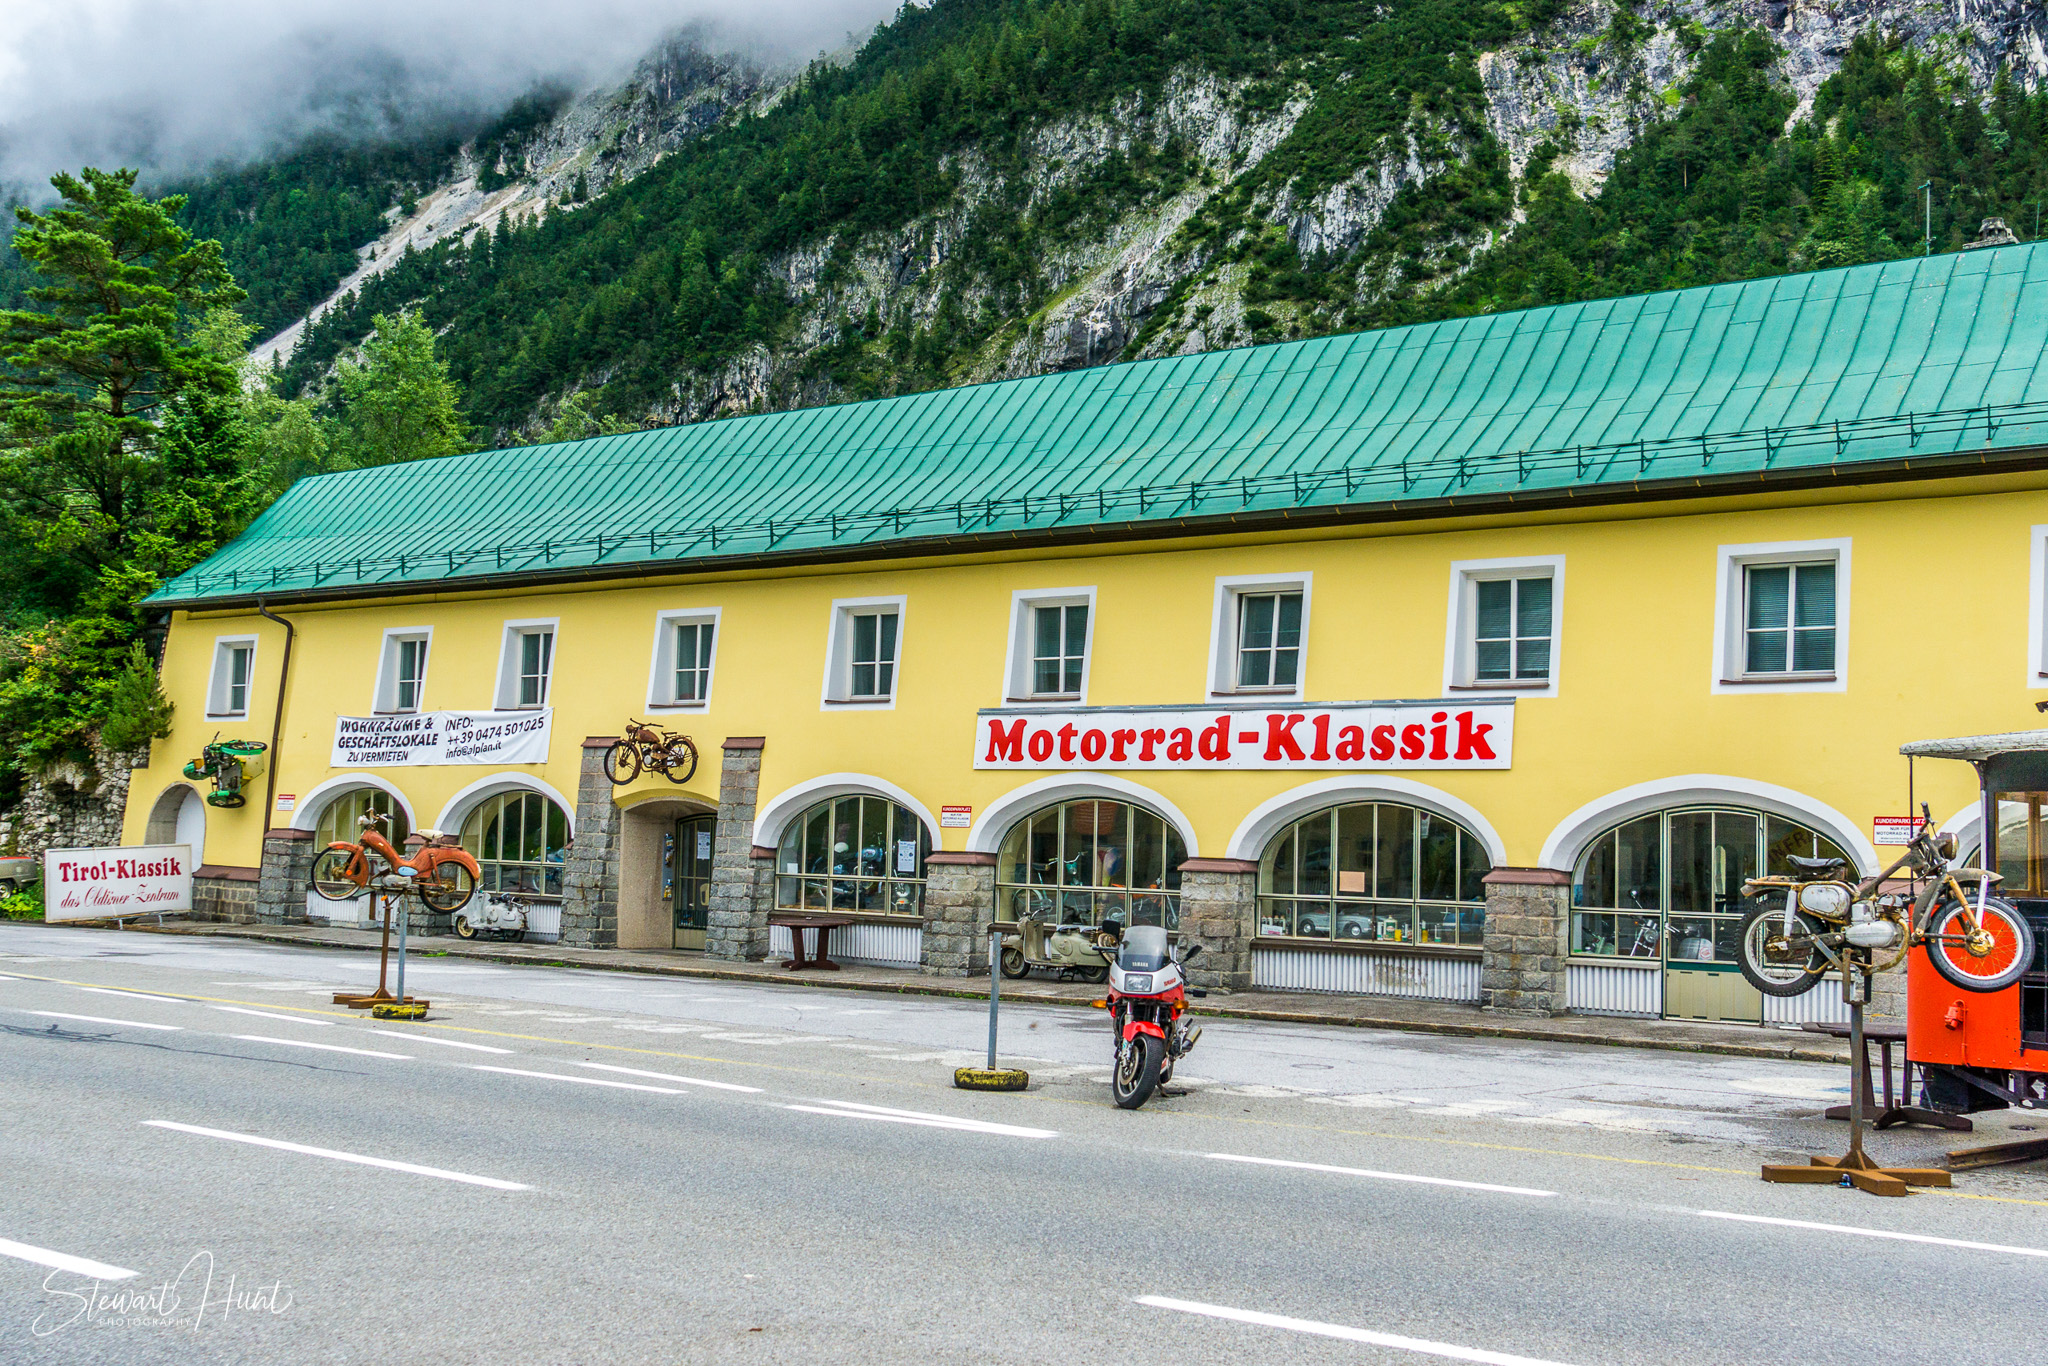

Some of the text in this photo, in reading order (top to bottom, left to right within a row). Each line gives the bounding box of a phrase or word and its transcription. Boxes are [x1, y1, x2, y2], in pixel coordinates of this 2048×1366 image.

[340, 718, 434, 733] WOHNRÄUME &
[445, 717, 474, 732] INFO:
[447, 716, 544, 746] ++39 0474 501025
[338, 733, 439, 749] GESCHÄFTSLOKALE
[984, 710, 1497, 763] Motorrad-Klassik
[347, 750, 409, 762] ZU VERMIETEN
[445, 740, 502, 760] info@alplan.it
[58, 857, 182, 882] Tirol-Klassik
[60, 890, 81, 909] das
